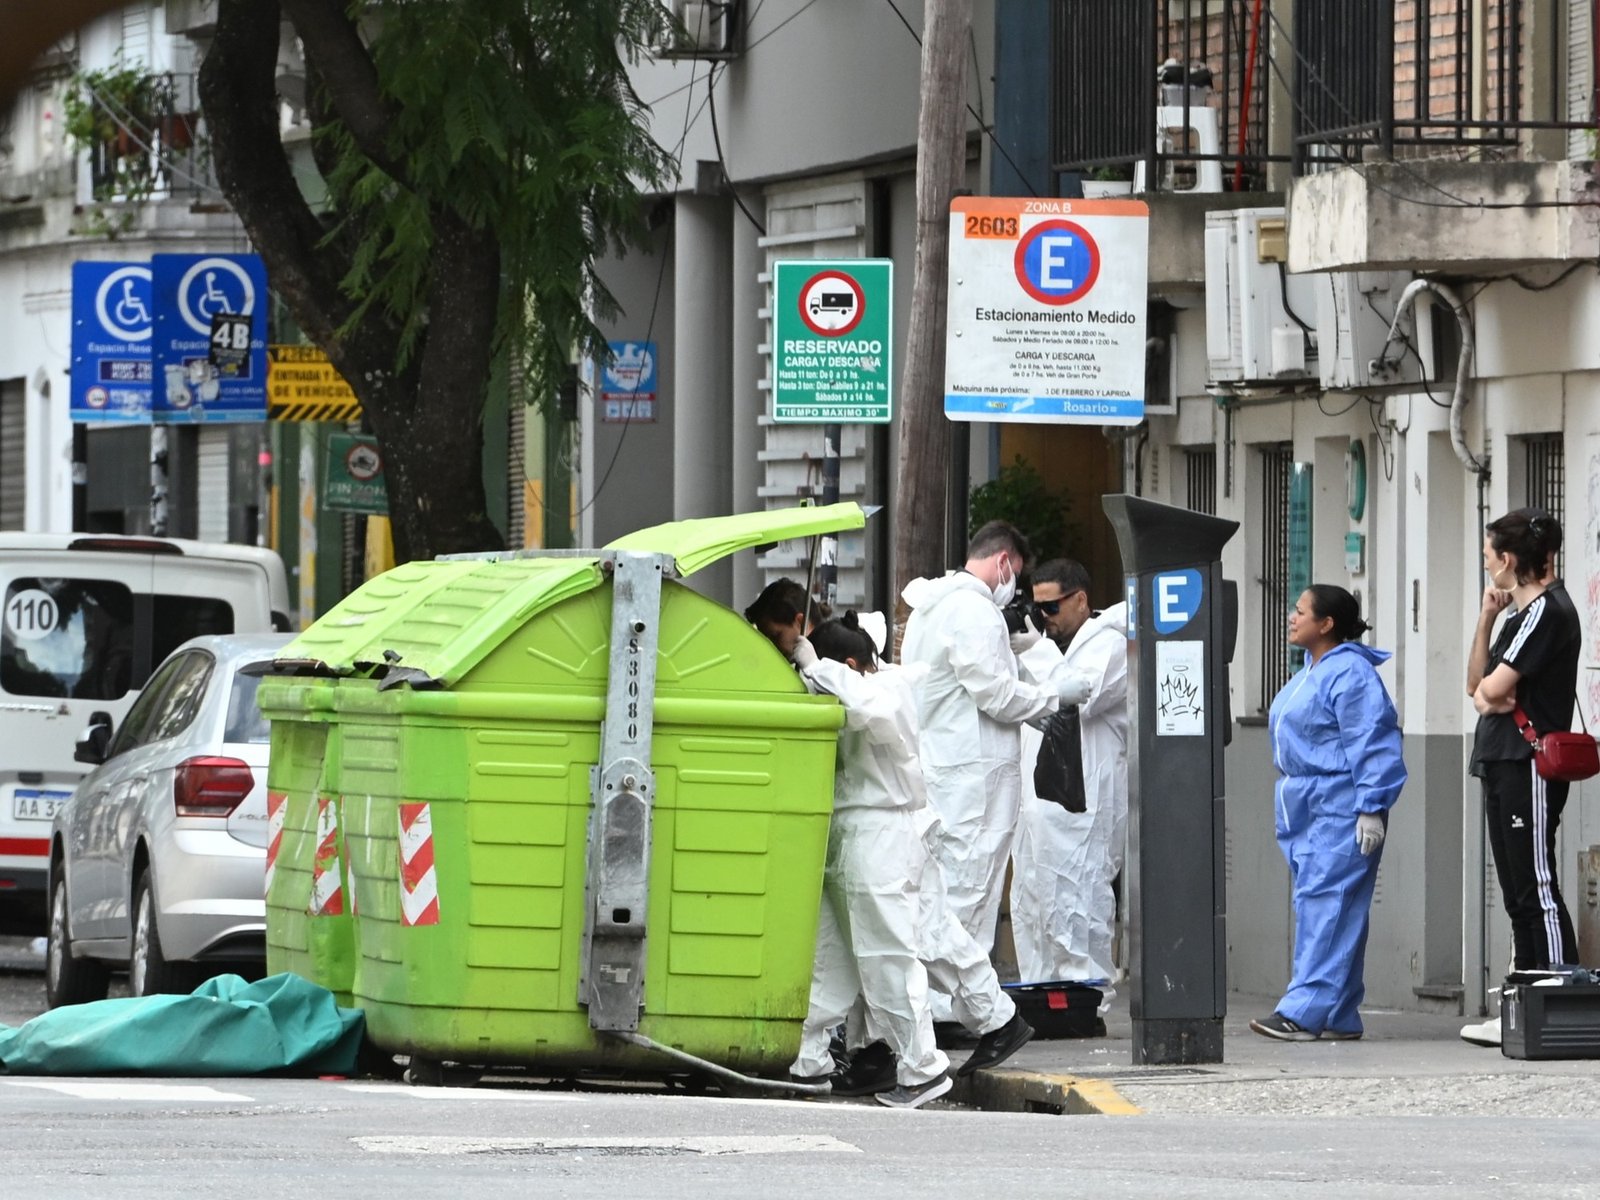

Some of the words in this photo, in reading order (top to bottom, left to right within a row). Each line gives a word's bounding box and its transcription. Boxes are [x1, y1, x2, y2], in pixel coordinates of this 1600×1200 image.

[1025, 202, 1060, 213] ZONA
[1062, 202, 1072, 214] B
[966, 216, 1018, 236] 2603
[1040, 236, 1072, 288] E
[976, 308, 1083, 323] Estacionamiento
[1088, 310, 1136, 324] Medido
[212, 322, 249, 349] 4B
[784, 340, 882, 354] RESERVADO
[785, 357, 819, 367] CARGA
[820, 357, 826, 367] Y
[1015, 351, 1042, 360] CARGA
[1045, 352, 1051, 360] Y
[1052, 352, 1096, 361] DESCARGA
[274, 369, 320, 381] ENTRADA
[779, 370, 797, 379] Hasta
[806, 370, 818, 379] ton:
[819, 370, 828, 379] De
[850, 370, 859, 379] hs.
[274, 385, 289, 397] DE
[296, 386, 352, 398] VEHICUL
[779, 382, 797, 390] Hasta
[803, 382, 815, 390] ton:
[866, 382, 874, 390] 21
[876, 382, 886, 390] hs.
[952, 384, 982, 393] Máquina
[984, 385, 998, 393] más
[1000, 386, 1030, 395] próxima:
[815, 392, 842, 401] Sábados
[855, 392, 863, 401] 14
[865, 392, 875, 401] hs.
[781, 408, 819, 416] TIEMPO
[822, 409, 862, 417] MAXIMO
[1064, 401, 1108, 413] Rosario
[1158, 576, 1188, 622] E
[12, 599, 53, 630] 110
[19, 800, 38, 816] AA
